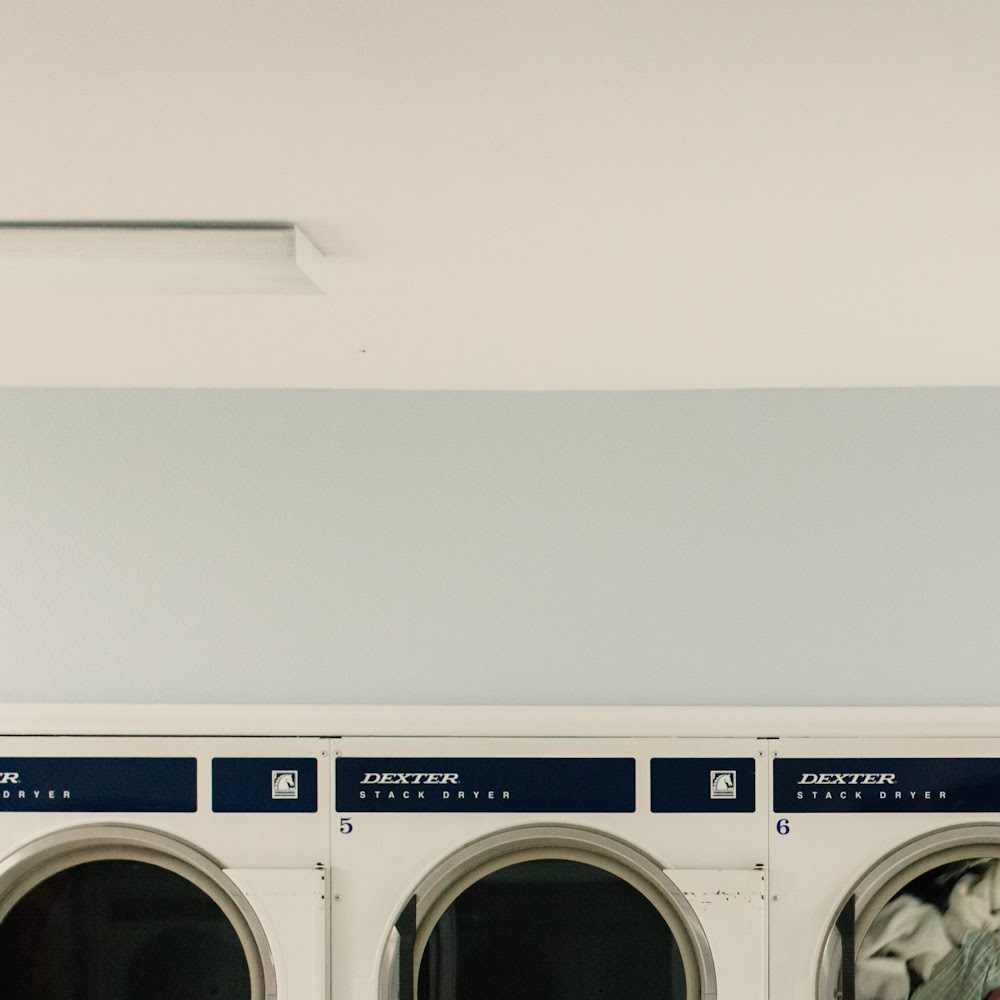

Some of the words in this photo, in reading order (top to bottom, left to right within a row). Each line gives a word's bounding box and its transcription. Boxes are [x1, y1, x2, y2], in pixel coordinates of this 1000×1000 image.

[360, 772, 459, 784] DEXTER
[797, 773, 896, 785] DEXTER
[3, 790, 71, 799] DRYER
[359, 790, 425, 799] STACK
[442, 790, 510, 799] DRYER
[796, 791, 862, 800] STACK
[879, 791, 946, 800] DRYER
[339, 817, 353, 834] 5
[776, 818, 790, 835] 6
